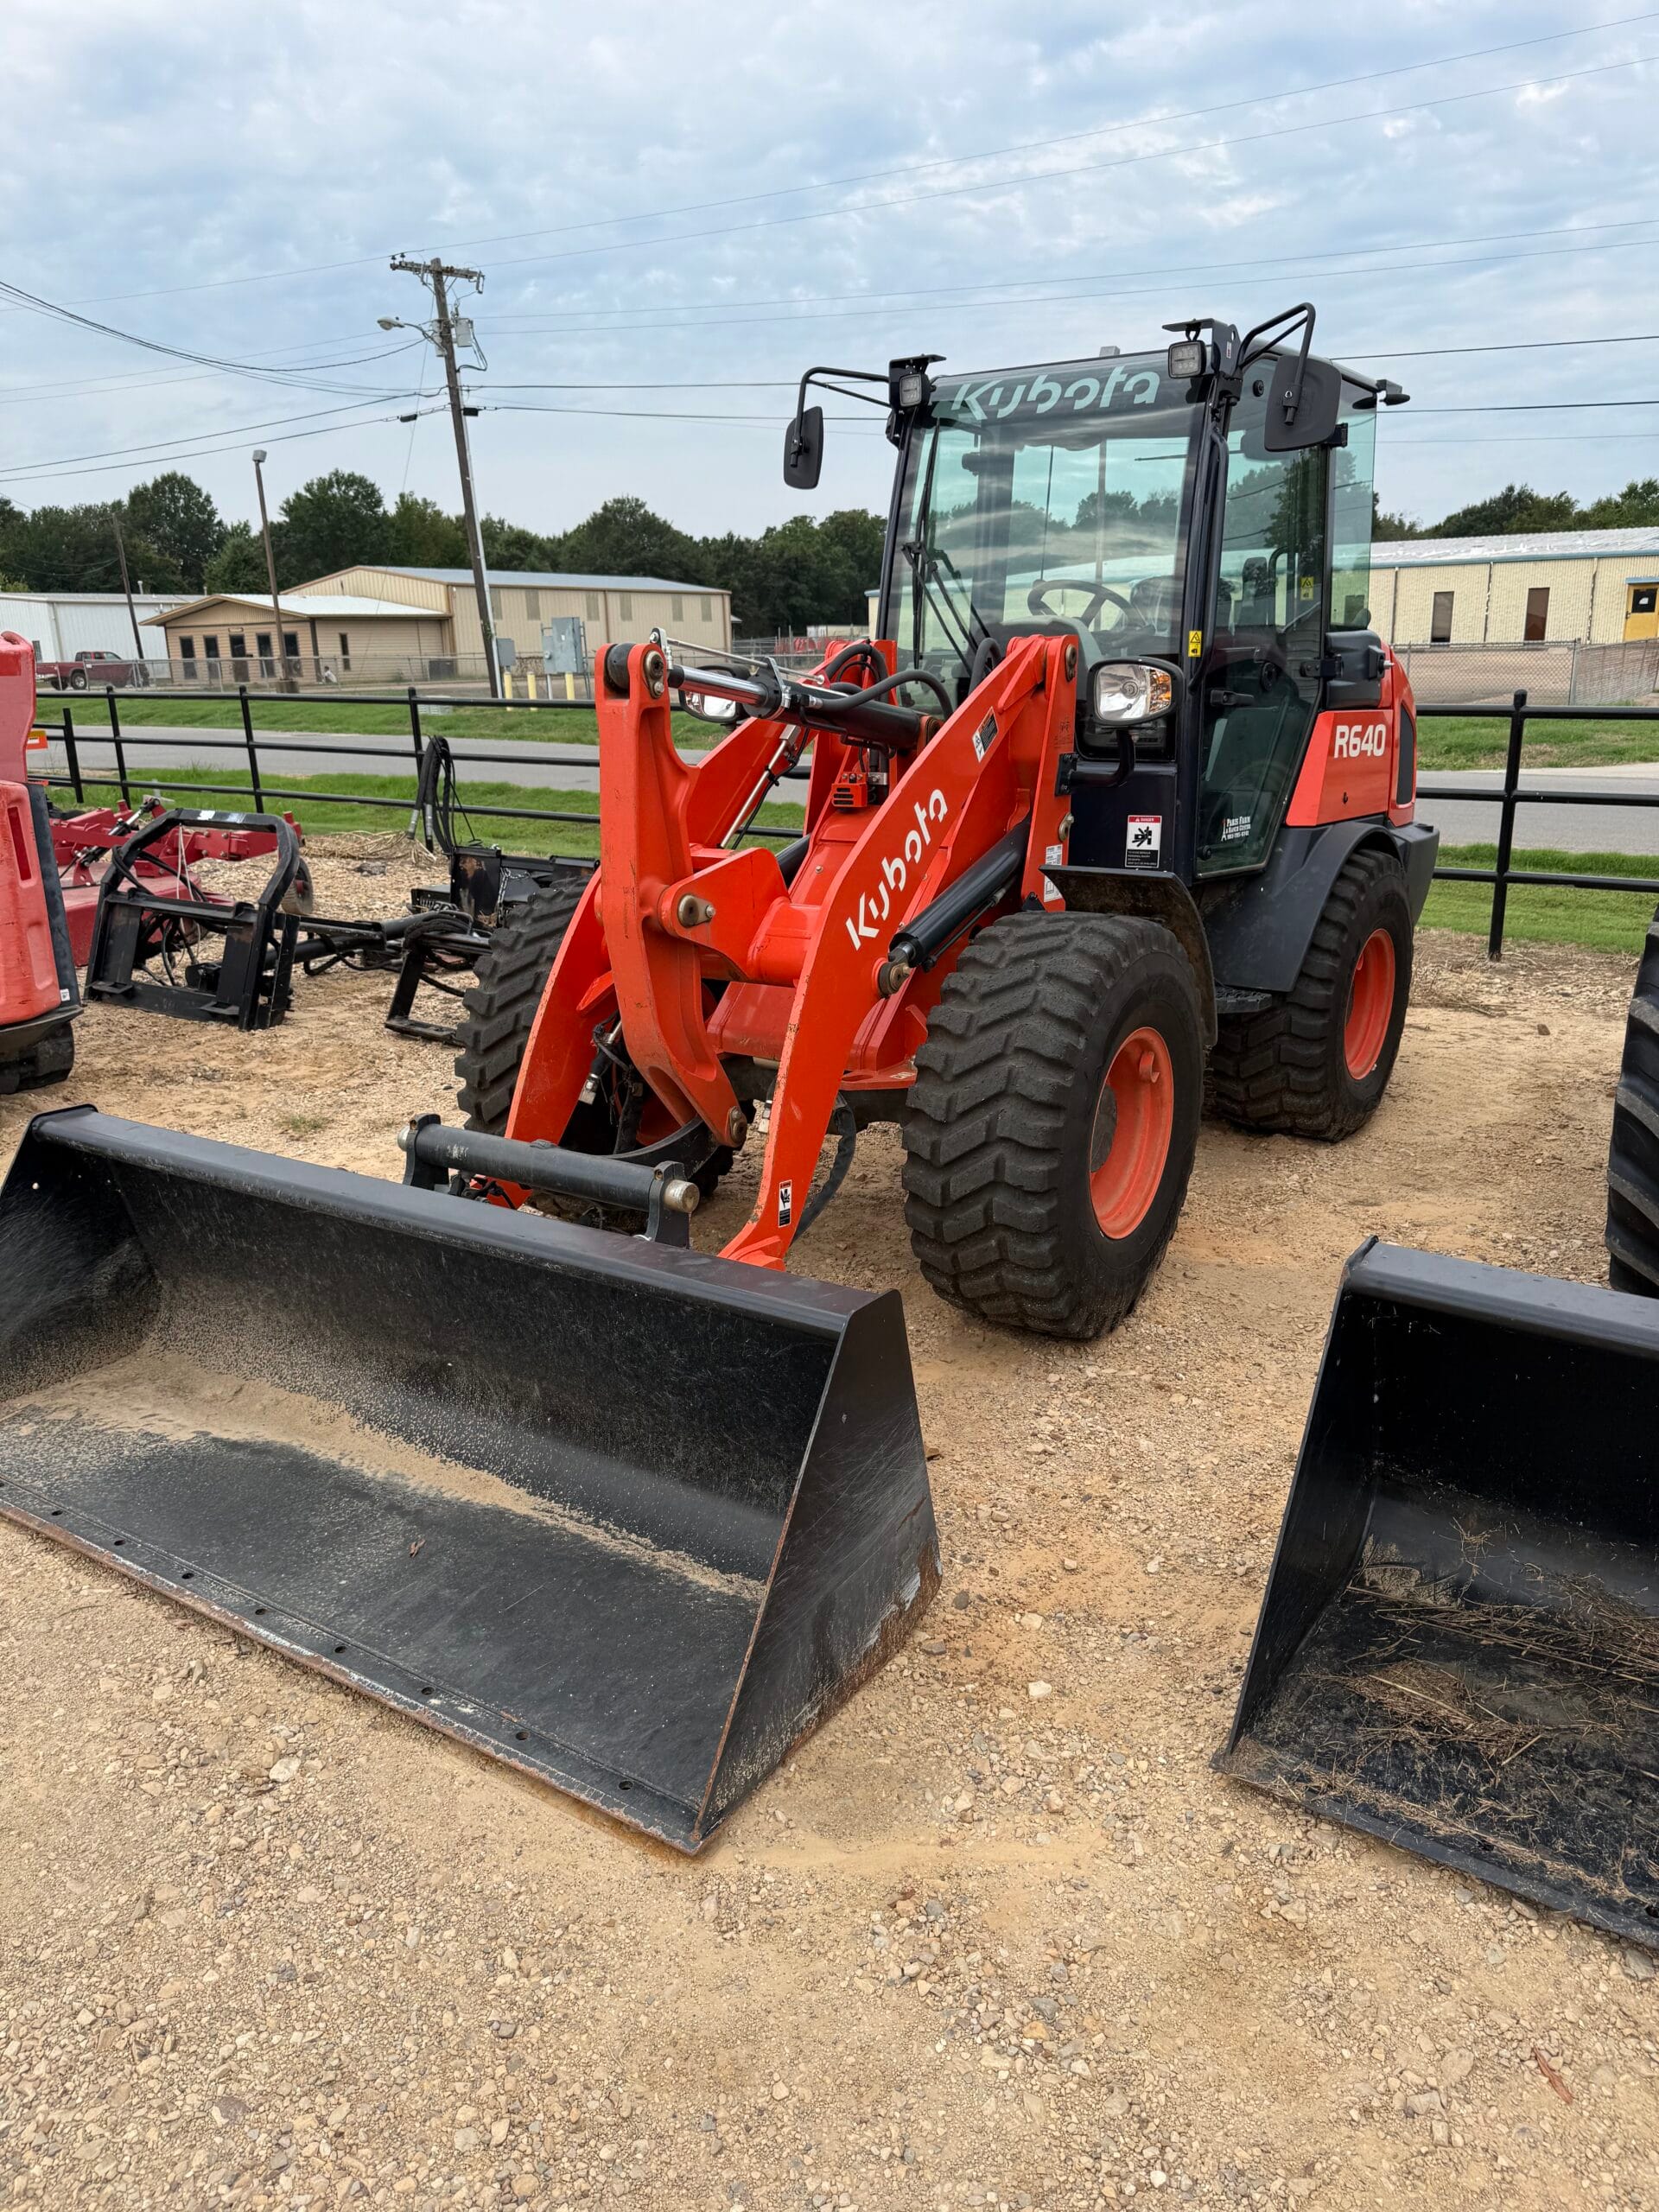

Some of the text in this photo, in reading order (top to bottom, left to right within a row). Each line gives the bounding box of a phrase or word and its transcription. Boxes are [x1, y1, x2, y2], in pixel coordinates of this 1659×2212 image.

[951, 365, 1160, 421] Kubota
[1333, 724, 1387, 759] R640
[845, 789, 949, 951] Kubota
